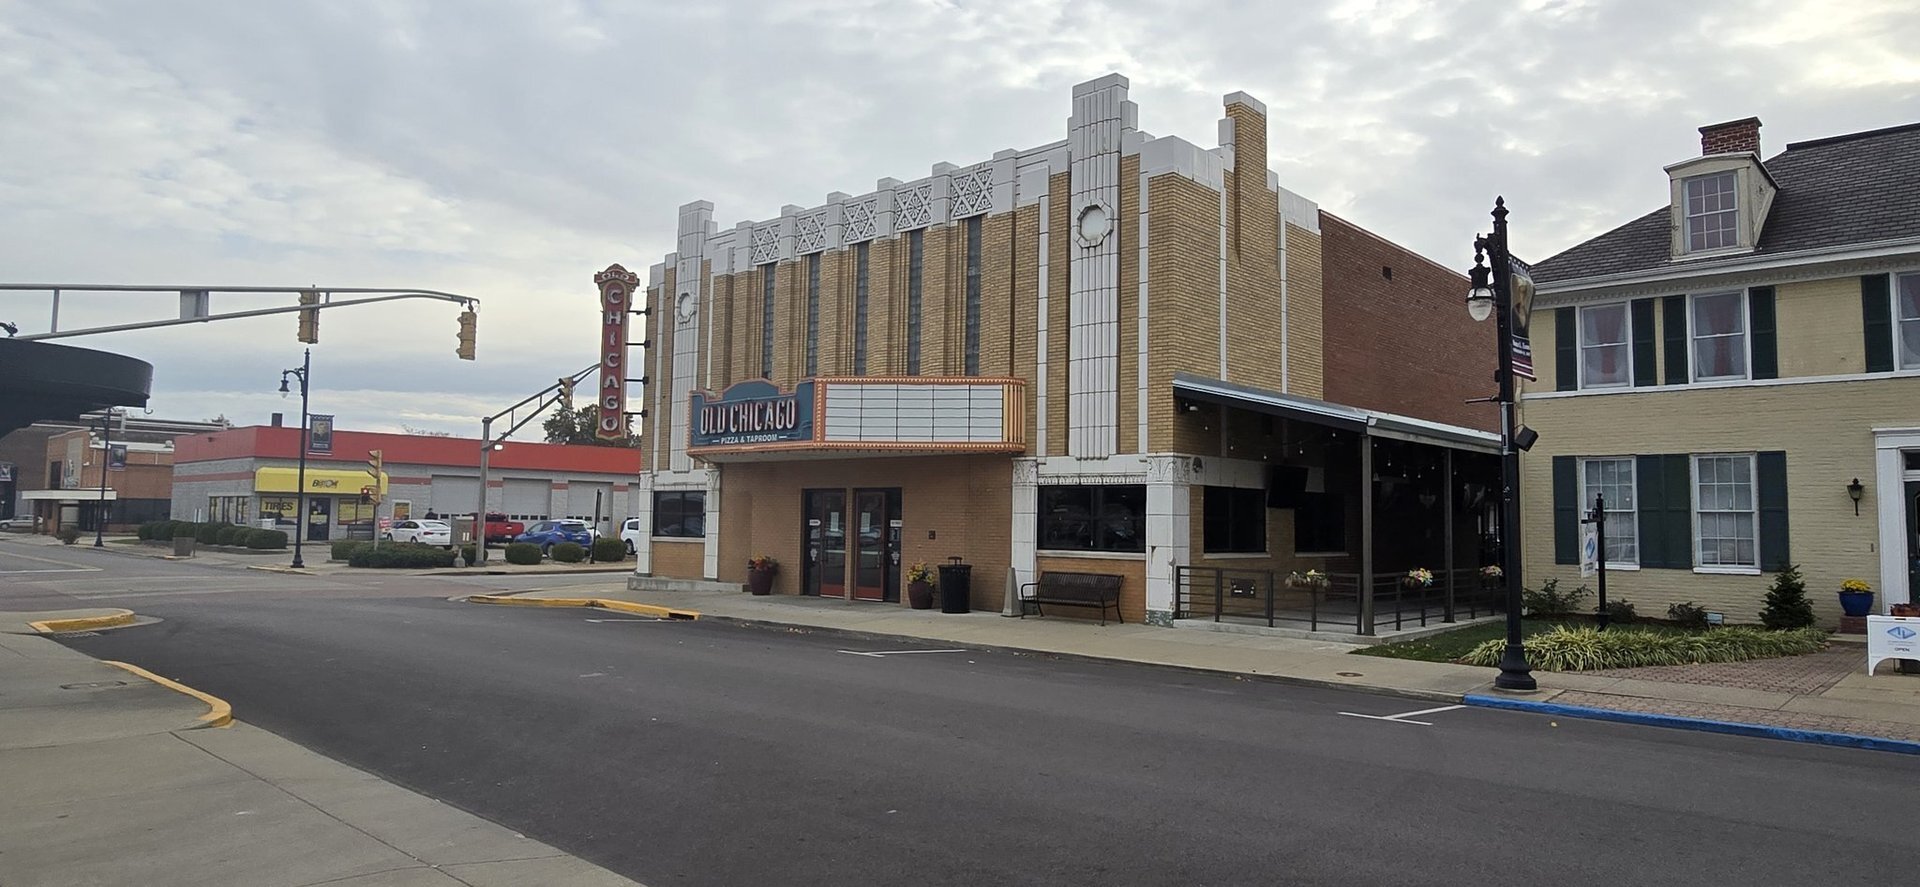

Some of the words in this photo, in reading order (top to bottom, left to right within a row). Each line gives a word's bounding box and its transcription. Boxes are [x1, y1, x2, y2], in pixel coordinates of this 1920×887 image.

[601, 290, 622, 431] CHICAGO
[701, 406, 726, 435] OLD
[730, 399, 795, 433] CHICAGO
[721, 436, 738, 445] PIZZA
[746, 434, 778, 443] TAPROOM
[265, 502, 293, 511] TIRES
